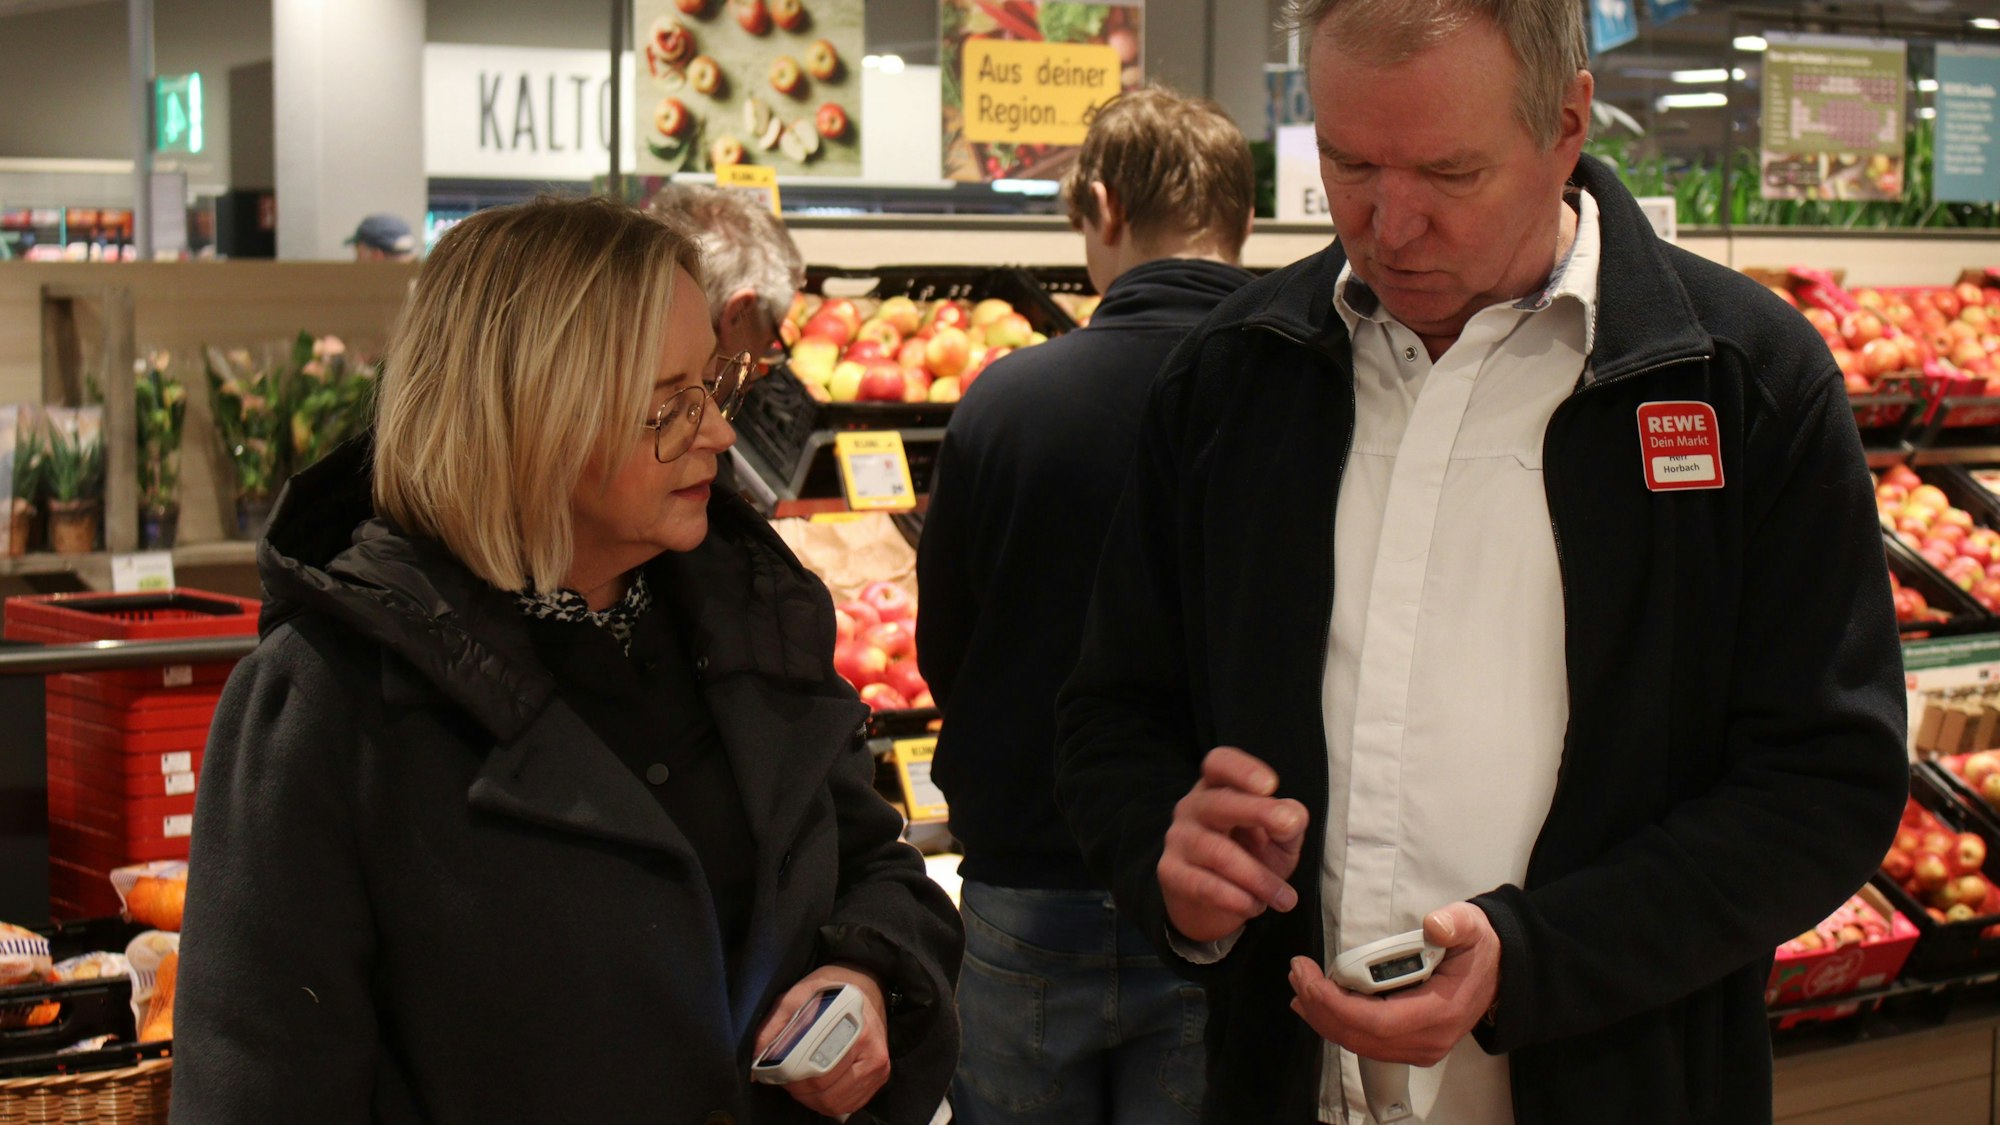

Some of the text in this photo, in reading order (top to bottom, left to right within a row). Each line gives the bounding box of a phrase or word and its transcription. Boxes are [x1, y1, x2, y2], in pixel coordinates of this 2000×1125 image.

[978, 54, 1107, 87] Aus deiner
[1647, 414, 1707, 433] REWE
[1650, 435, 1710, 448] Dein Markt
[1663, 463, 1700, 473] Horbach
